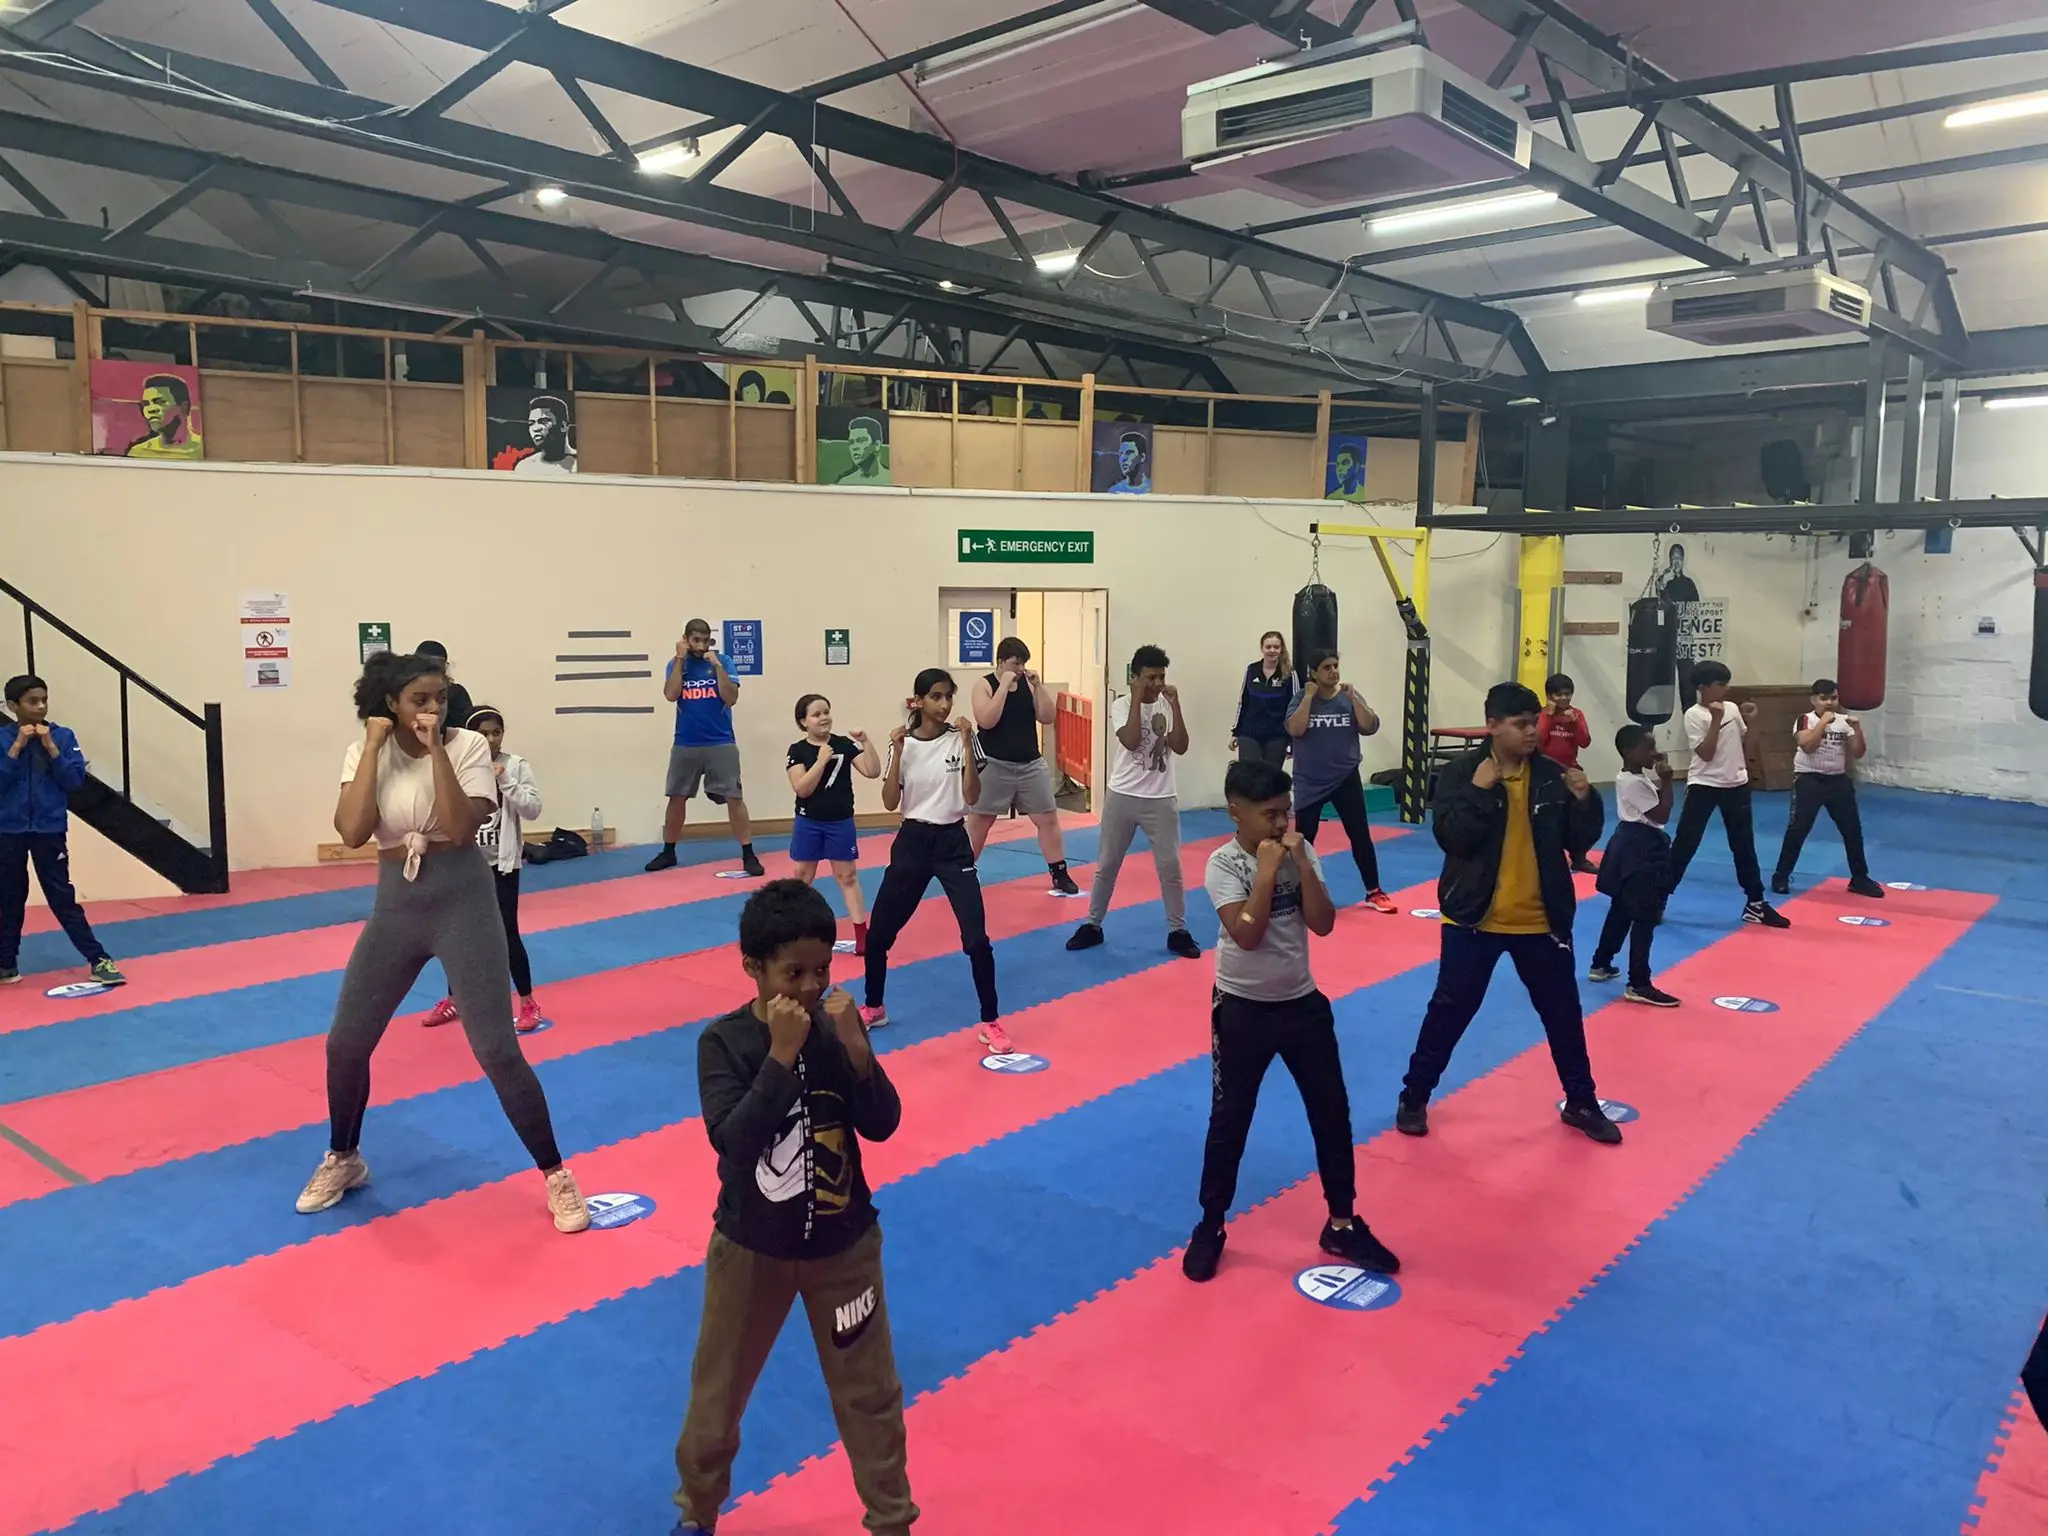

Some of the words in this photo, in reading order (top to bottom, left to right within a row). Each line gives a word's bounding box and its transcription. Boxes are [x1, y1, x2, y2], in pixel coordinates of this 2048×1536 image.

[1000, 540, 1065, 553] EMERGENCY
[1067, 541, 1090, 553] EXIT
[682, 687, 718, 700] NDIA
[1308, 717, 1351, 728] STYLE
[835, 1286, 876, 1332] NIKE
